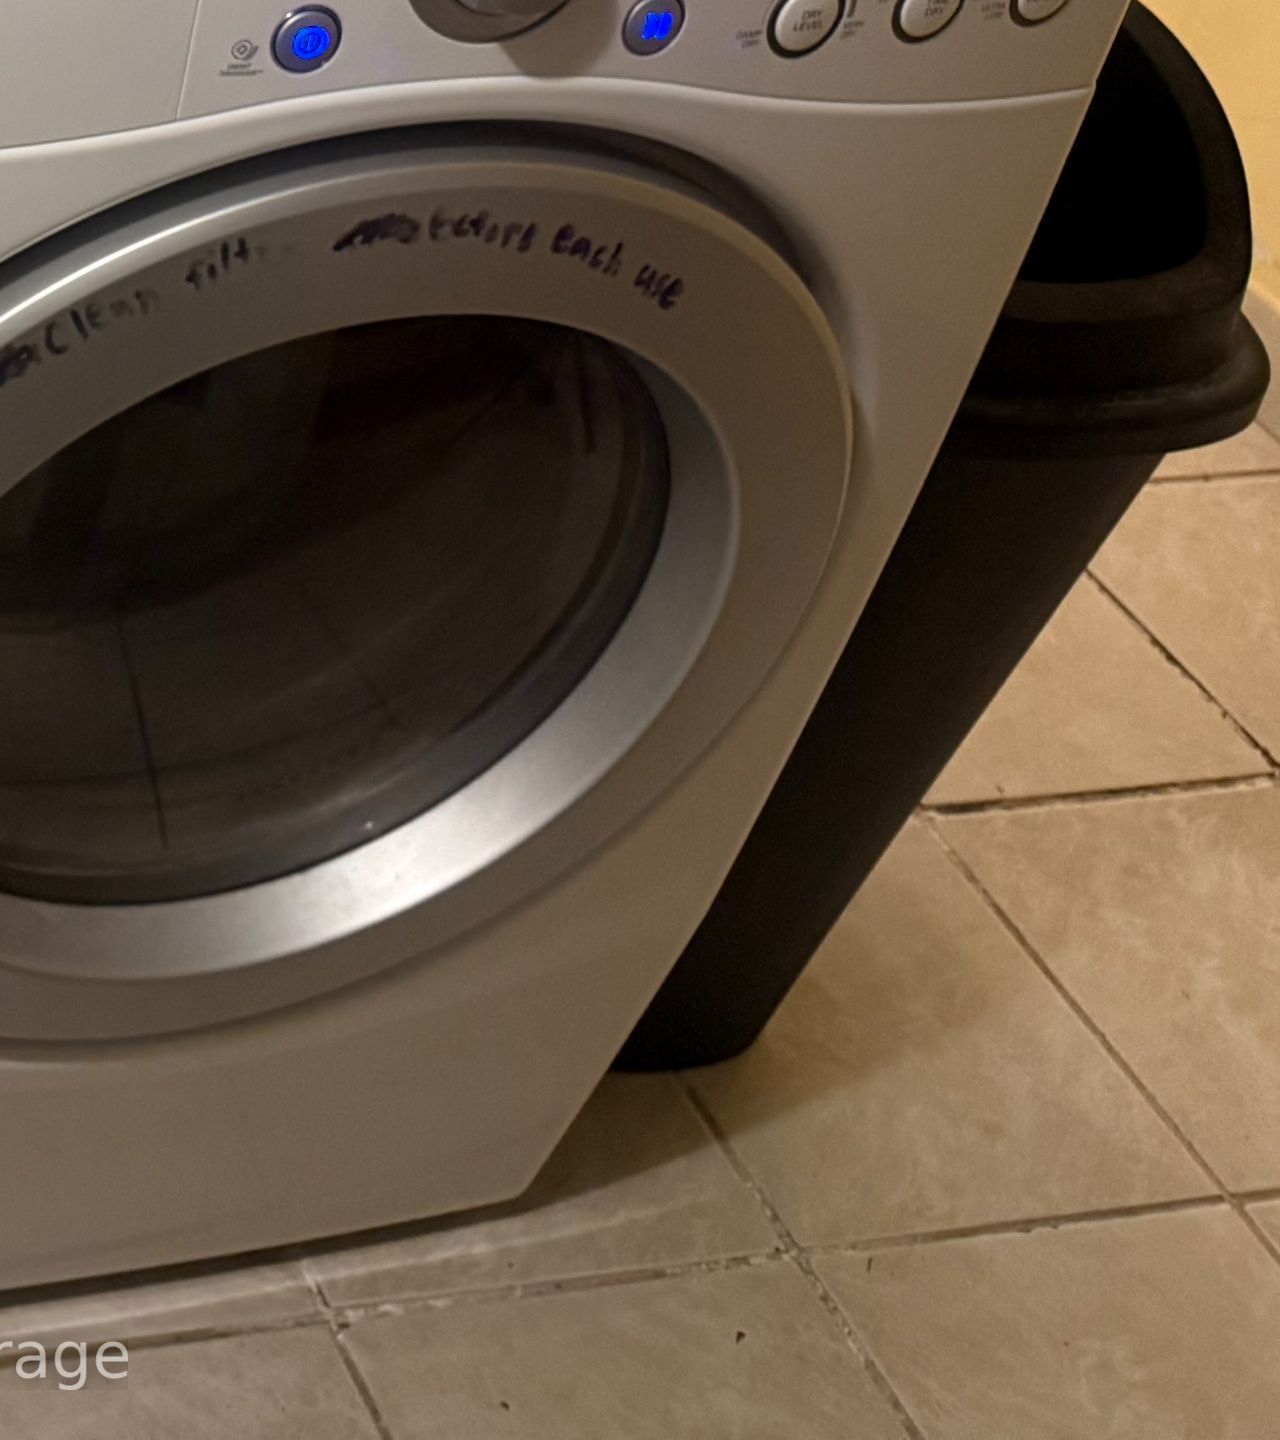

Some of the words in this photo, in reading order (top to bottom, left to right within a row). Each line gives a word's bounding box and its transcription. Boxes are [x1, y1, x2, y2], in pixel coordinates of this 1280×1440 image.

[801, 10, 823, 20] DRY
[792, 21, 824, 32] LEVEL
[551, 224, 624, 278] each
[634, 264, 684, 311] use
